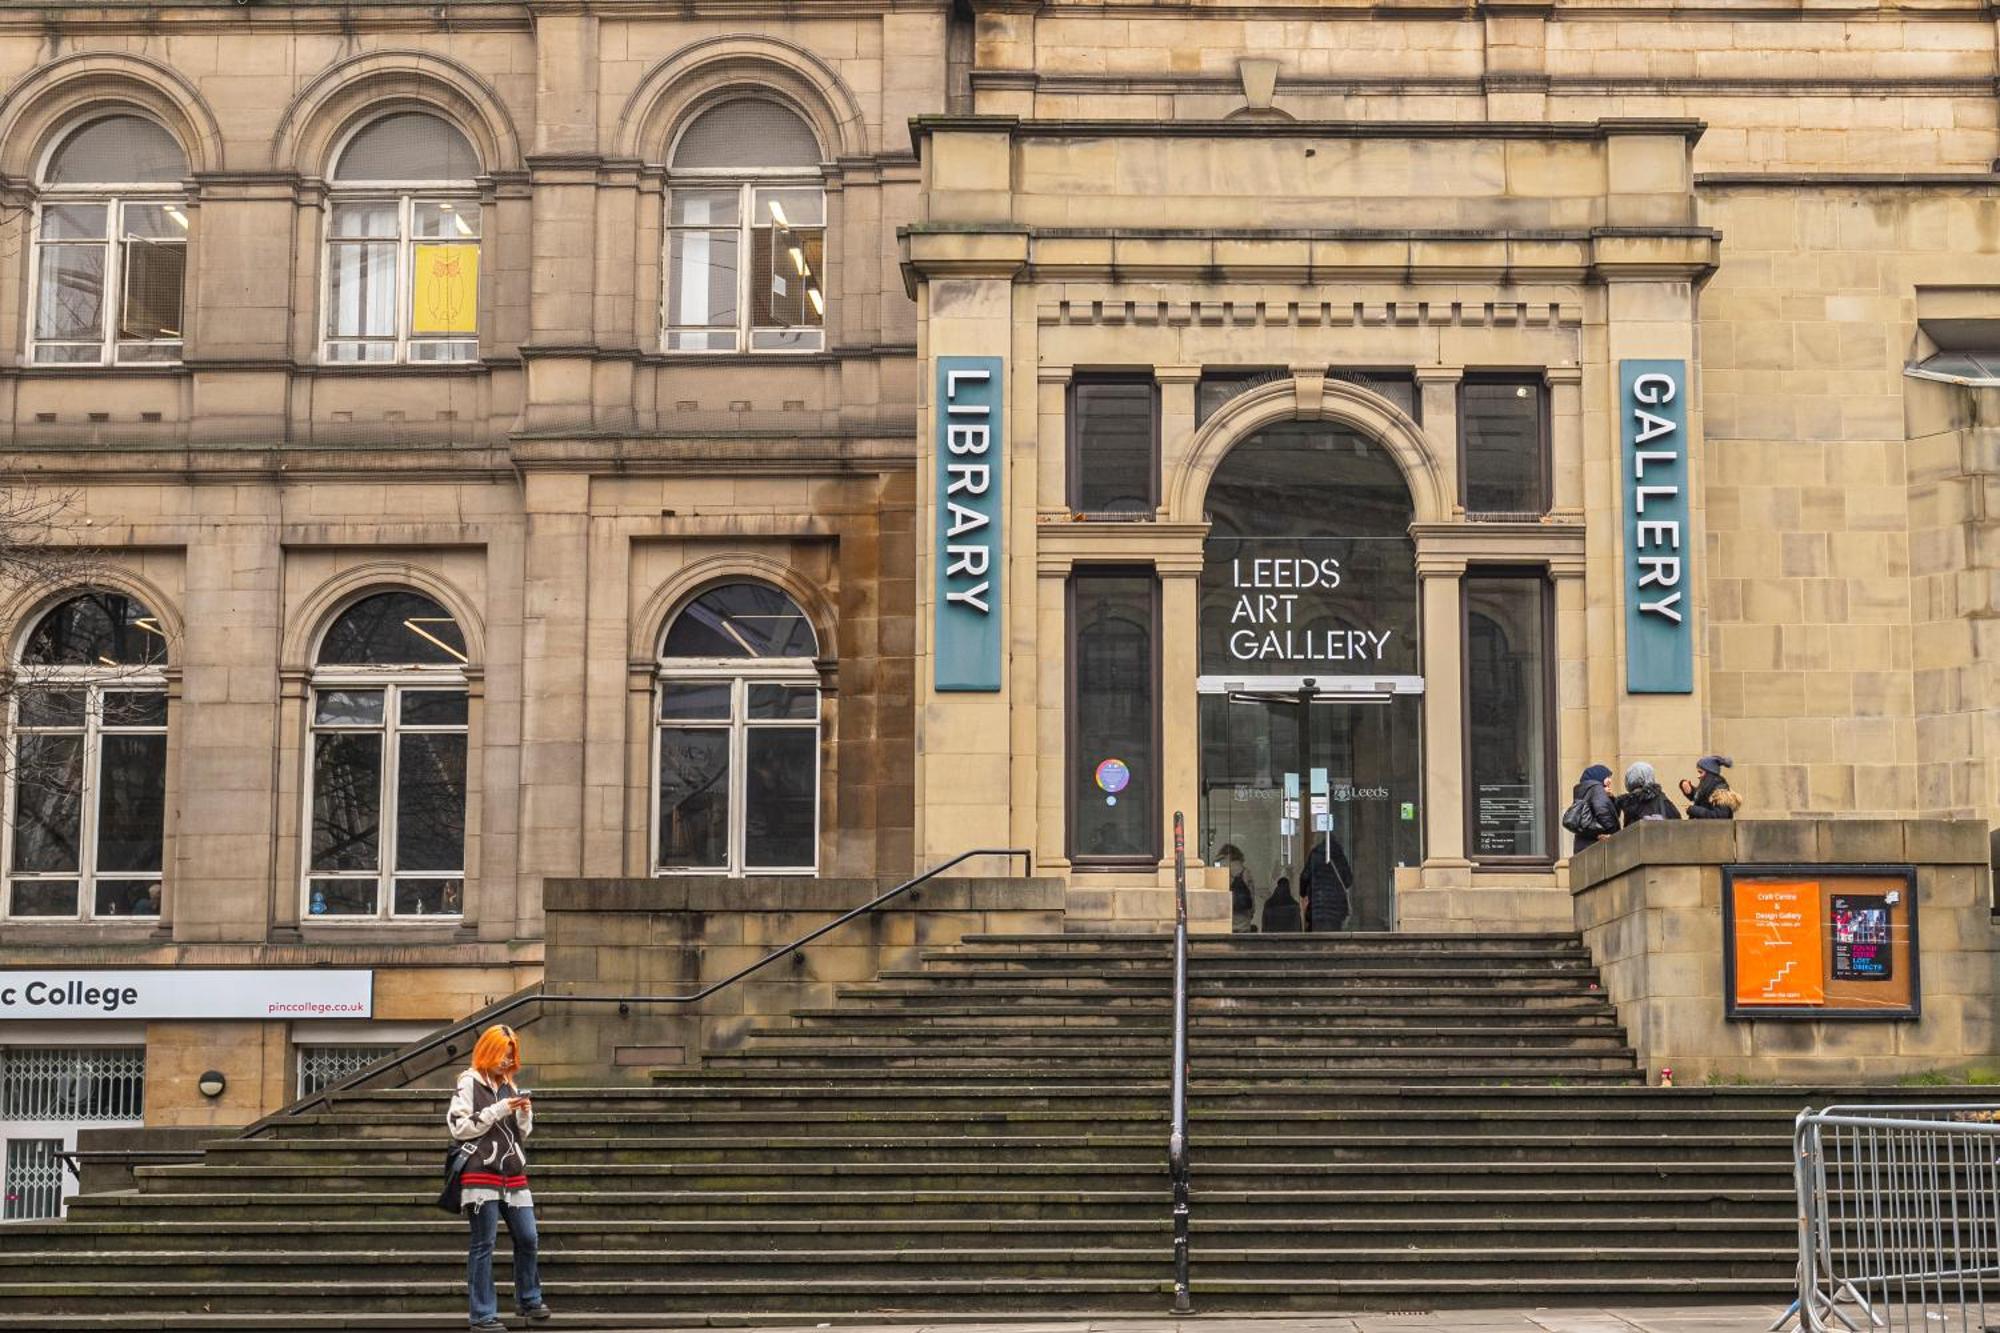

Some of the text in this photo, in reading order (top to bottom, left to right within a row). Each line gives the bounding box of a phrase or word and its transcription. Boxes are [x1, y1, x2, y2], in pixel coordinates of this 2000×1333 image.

[946, 369, 991, 613] LIBRARY
[1633, 372, 1683, 622] GALLERY
[1233, 558, 1341, 589] LEEDS
[1231, 594, 1299, 624] ART
[1230, 629, 1392, 660] GALLERY
[1351, 786, 1389, 798] Leeds
[25, 980, 138, 1012] College
[268, 1002, 364, 1014] pinccollege.co.uk
